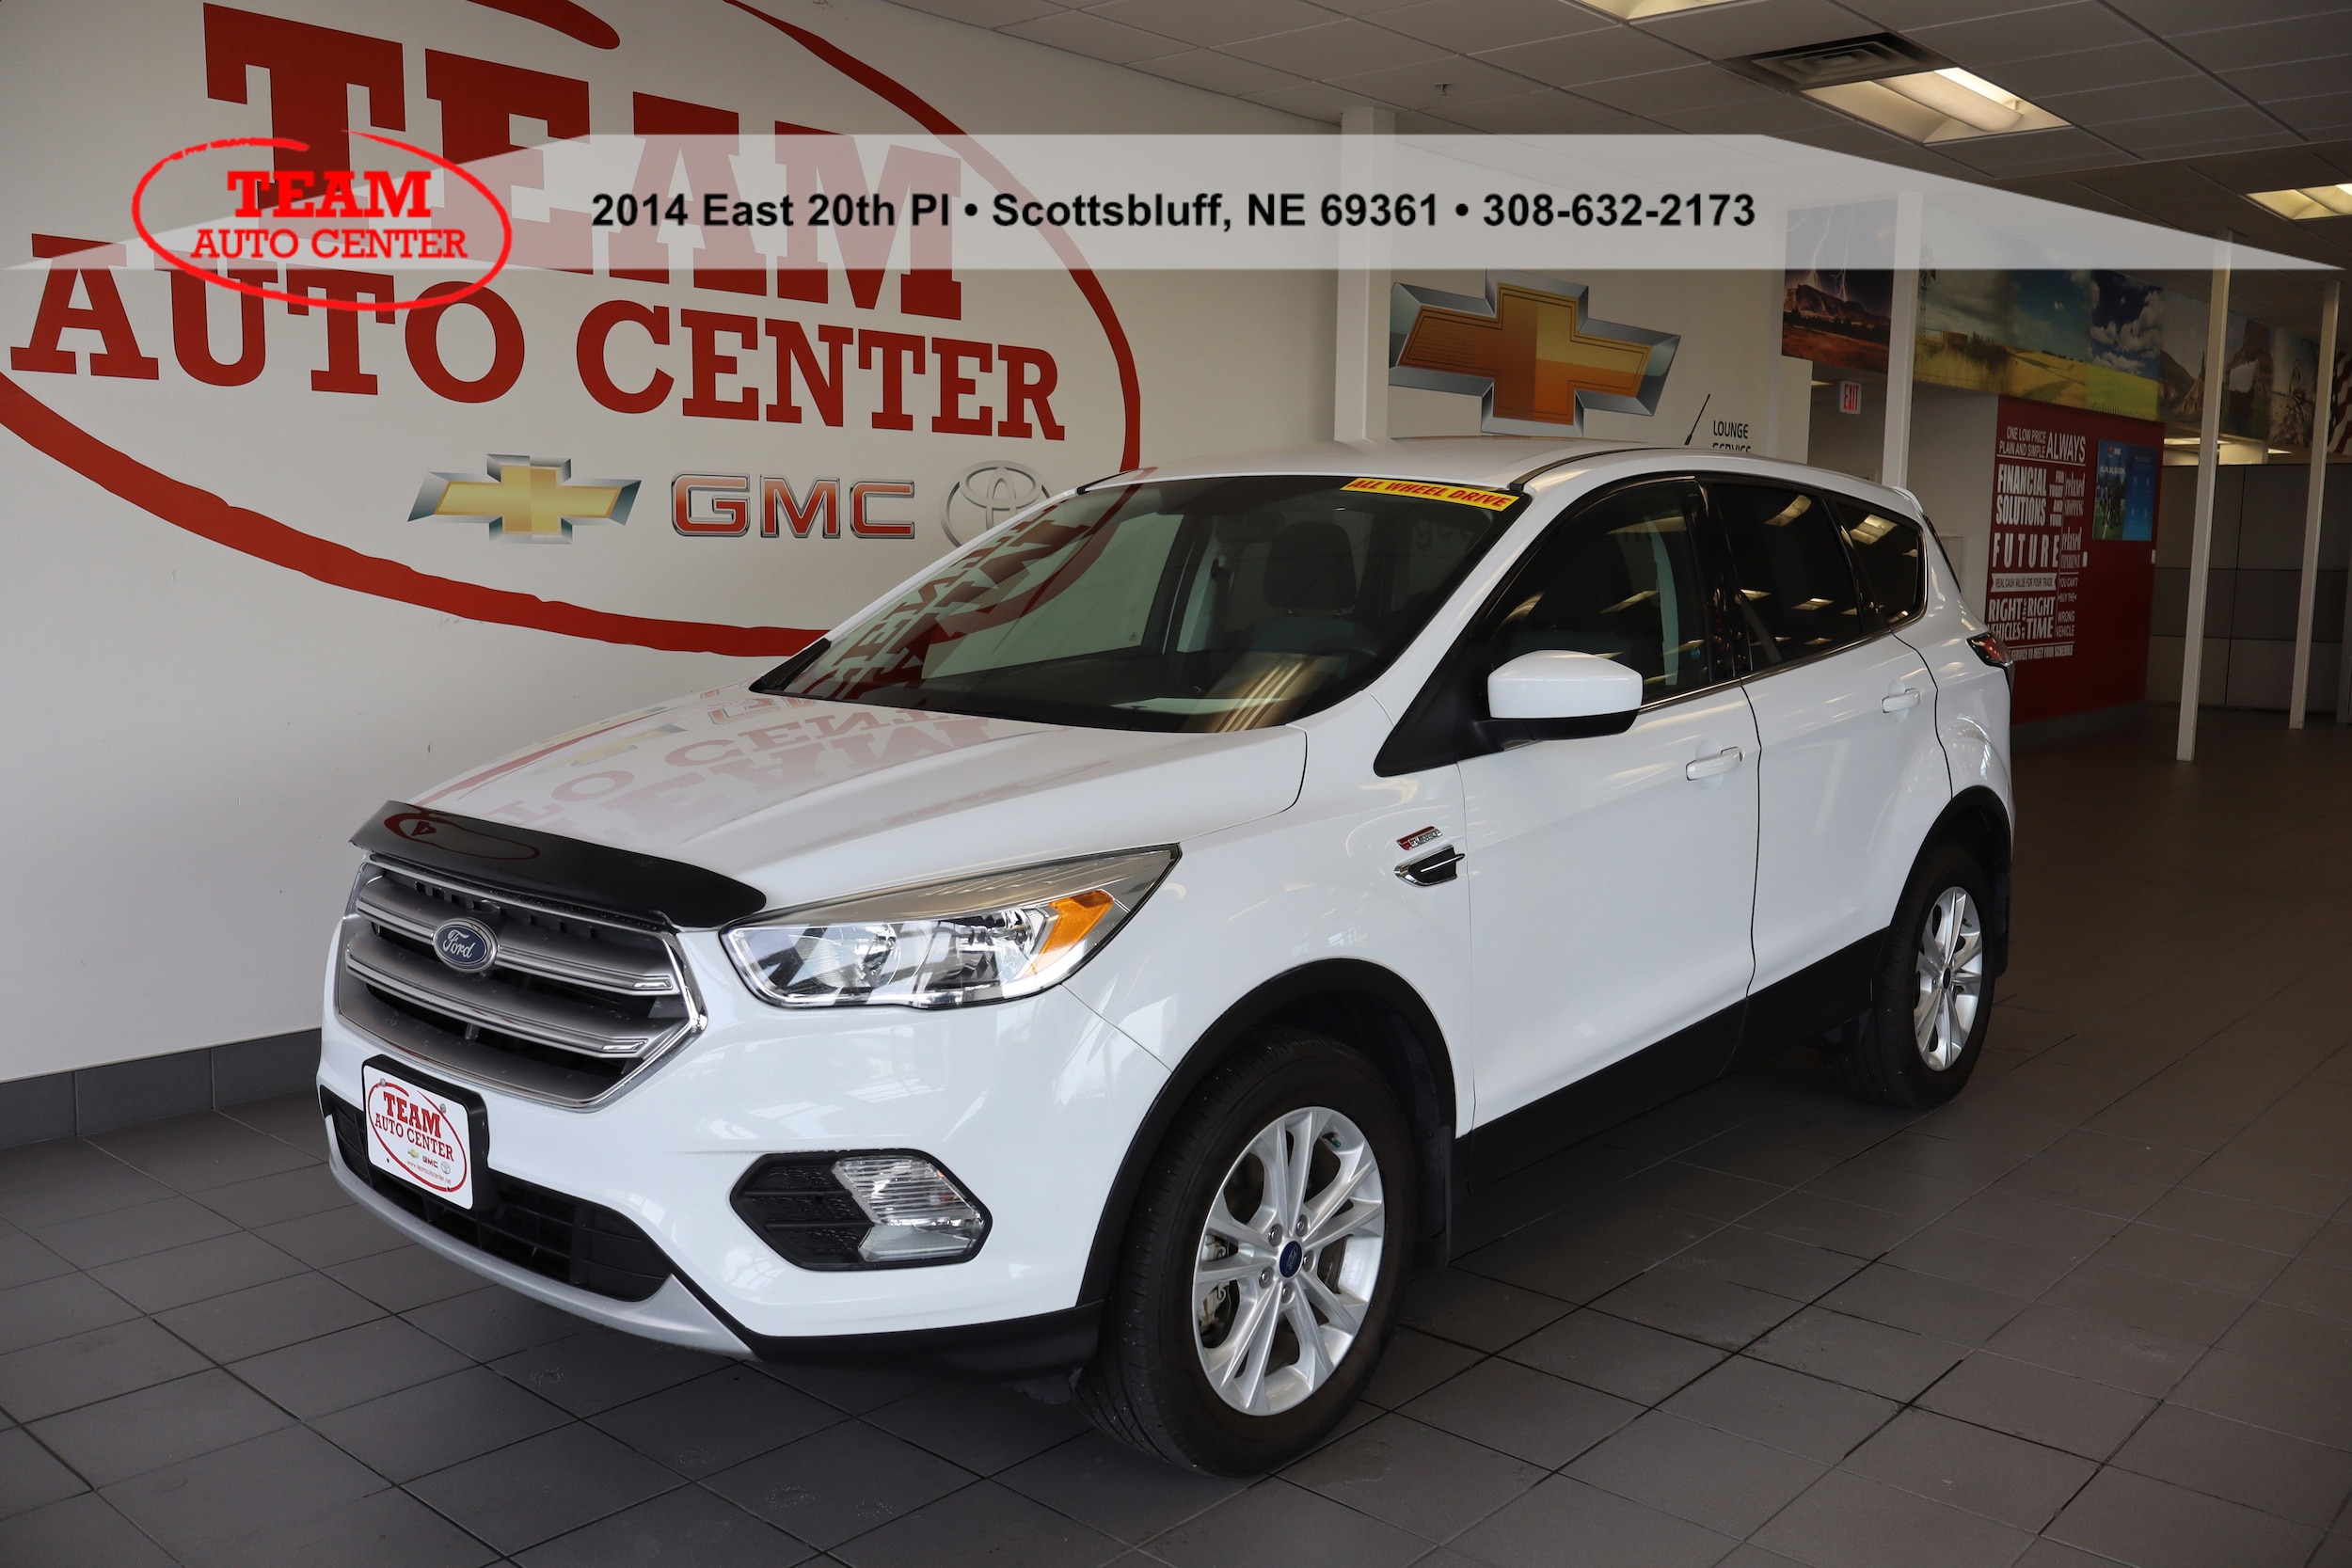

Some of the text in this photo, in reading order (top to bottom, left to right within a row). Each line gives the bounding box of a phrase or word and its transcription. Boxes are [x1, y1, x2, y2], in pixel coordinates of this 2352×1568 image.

[203, 3, 961, 320] TEAM
[10, 232, 1065, 440] AUTO CENTER
[1844, 384, 1859, 410] EXIT
[1712, 420, 1749, 439] LOUNGE
[2007, 426, 2046, 443] ONE LOW PRICE
[1999, 440, 2045, 458] PLAIN AND SIMPLE
[2046, 432, 2086, 463] ALWAYS
[1347, 480, 1511, 507] ALL WHEEL DRIVE
[1997, 464, 2047, 497] FINANCIAL
[671, 472, 916, 539] GMC
[1995, 495, 2046, 527] SOLUTIONS
[1992, 532, 2059, 568] FUTURE
[1996, 578, 2005, 588] REAL
[2005, 578, 2014, 588] CASH
[2015, 578, 2026, 587] VALUE
[1988, 597, 2023, 623] RIGHT
[2027, 595, 2056, 617] RIGHT
[2026, 617, 2054, 640] TIME
[2056, 625, 2075, 638] VEHICLE
[442, 929, 476, 958] Ford
[383, 1091, 442, 1138] TEAM
[374, 1113, 454, 1162] AUTO CENTER
[422, 1156, 438, 1169] GMC
